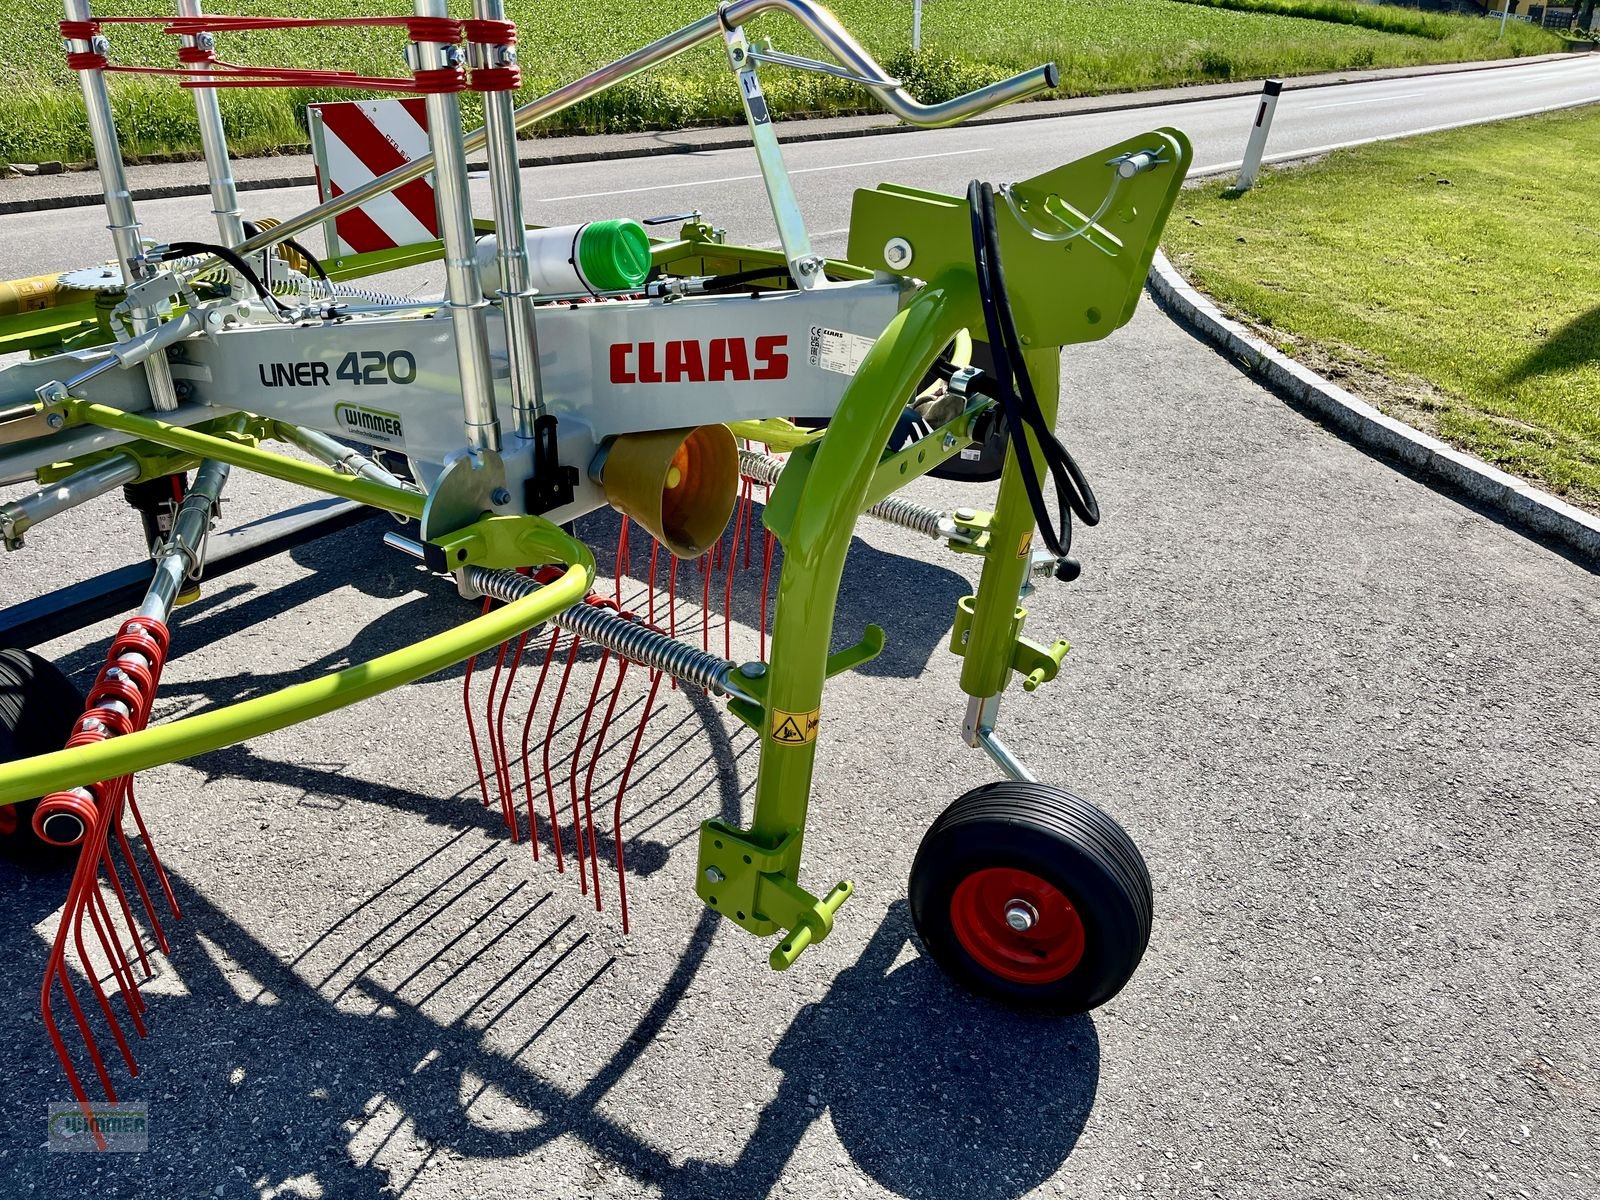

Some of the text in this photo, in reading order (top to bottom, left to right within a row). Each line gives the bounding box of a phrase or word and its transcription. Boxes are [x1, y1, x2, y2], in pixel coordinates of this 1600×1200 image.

[823, 329, 843, 338] CLAAS
[258, 349, 417, 387] LINER 420
[609, 335, 789, 384] CLAAS
[344, 408, 403, 437] WIMMER
